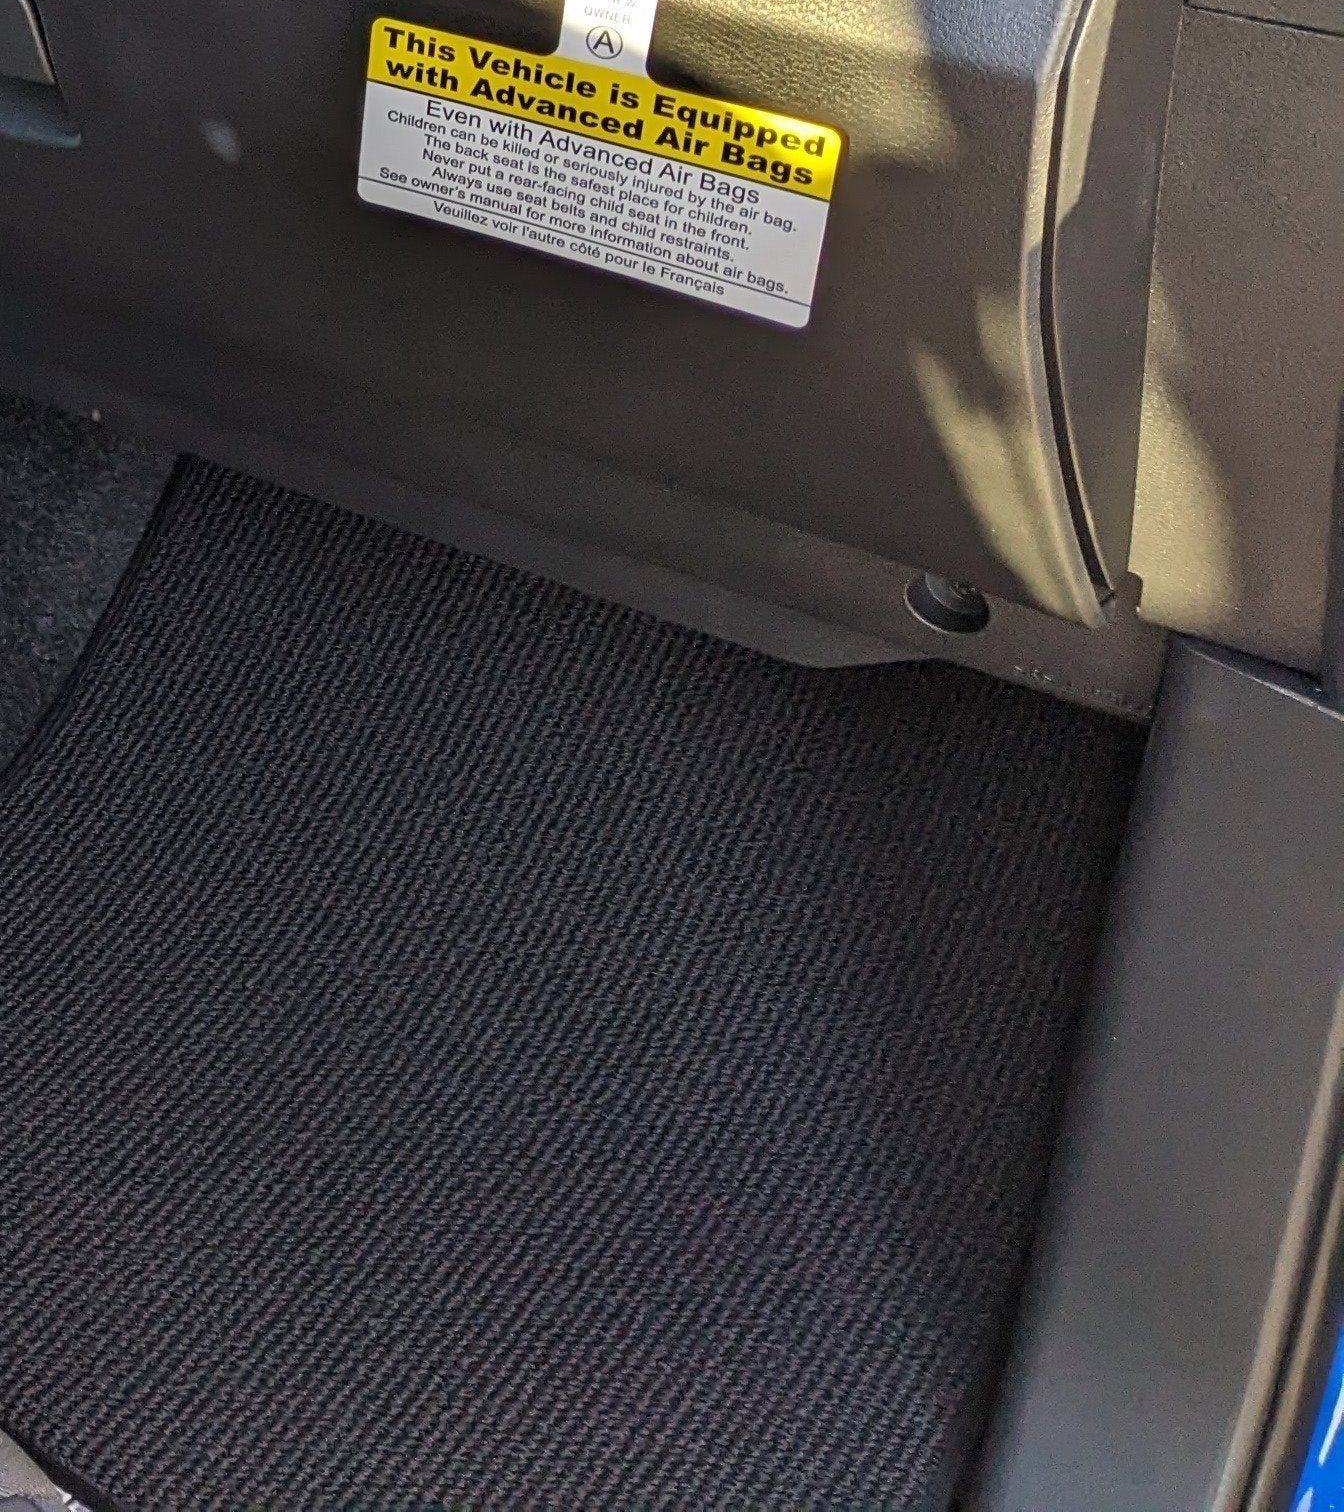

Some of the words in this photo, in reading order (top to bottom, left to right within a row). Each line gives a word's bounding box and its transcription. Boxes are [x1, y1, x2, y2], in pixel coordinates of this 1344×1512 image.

[584, 6, 632, 25] OWNER
[383, 26, 457, 63] This
[468, 46, 597, 99] Vehicle
[609, 82, 640, 109] is
[652, 93, 826, 159] Equipped
[385, 59, 459, 92] with
[469, 77, 645, 141] Advanced
[654, 126, 711, 157] Air
[720, 141, 814, 185] Bags
[387, 110, 446, 135] Children
[450, 128, 476, 143] can
[480, 133, 499, 148] be
[502, 139, 540, 160] killed
[543, 152, 560, 164] or
[562, 157, 629, 187] seriously
[632, 175, 684, 200] injured
[687, 190, 707, 208] by
[710, 196, 735, 214] the
[739, 206, 761, 221] air
[763, 211, 797, 233] bag.
[422, 148, 465, 170] Never
[468, 162, 492, 178] put
[494, 170, 505, 181] a
[507, 172, 586, 206] rear-facing
[589, 195, 625, 215] child
[628, 207, 661, 226] seat
[664, 215, 678, 230] in
[682, 221, 707, 238] the
[710, 228, 750, 251] front.
[424, 133, 451, 151] The
[455, 141, 490, 162] back
[492, 153, 524, 171] seat
[528, 163, 540, 175] is
[543, 166, 567, 183] the
[570, 174, 615, 197] safest
[618, 187, 659, 208] place
[663, 199, 685, 216] for
[687, 208, 753, 236] children.
[426, 99, 482, 129] Even
[488, 118, 533, 143] with
[538, 130, 654, 176] Advanced
[658, 162, 694, 186] Air
[699, 172, 761, 205] Bags
[379, 166, 408, 185] See
[411, 177, 466, 200] owner's
[469, 192, 523, 217] manual
[525, 206, 547, 223] for
[549, 215, 587, 234] more
[590, 224, 672, 261] information
[675, 251, 720, 274] about
[722, 265, 744, 280] air
[746, 270, 789, 295] bags.
[431, 166, 483, 191] Always
[486, 182, 513, 198] use
[516, 190, 548, 209] seat
[551, 199, 586, 220] belts
[589, 211, 618, 229] and
[621, 221, 657, 240] child
[660, 232, 735, 263] restraints.
[433, 200, 489, 227] Veuillez
[491, 218, 519, 235] voir
[521, 225, 566, 249] l'autre
[569, 238, 602, 259] côté
[604, 252, 639, 274] pour
[642, 259, 656, 274] le
[659, 265, 726, 297] Français
